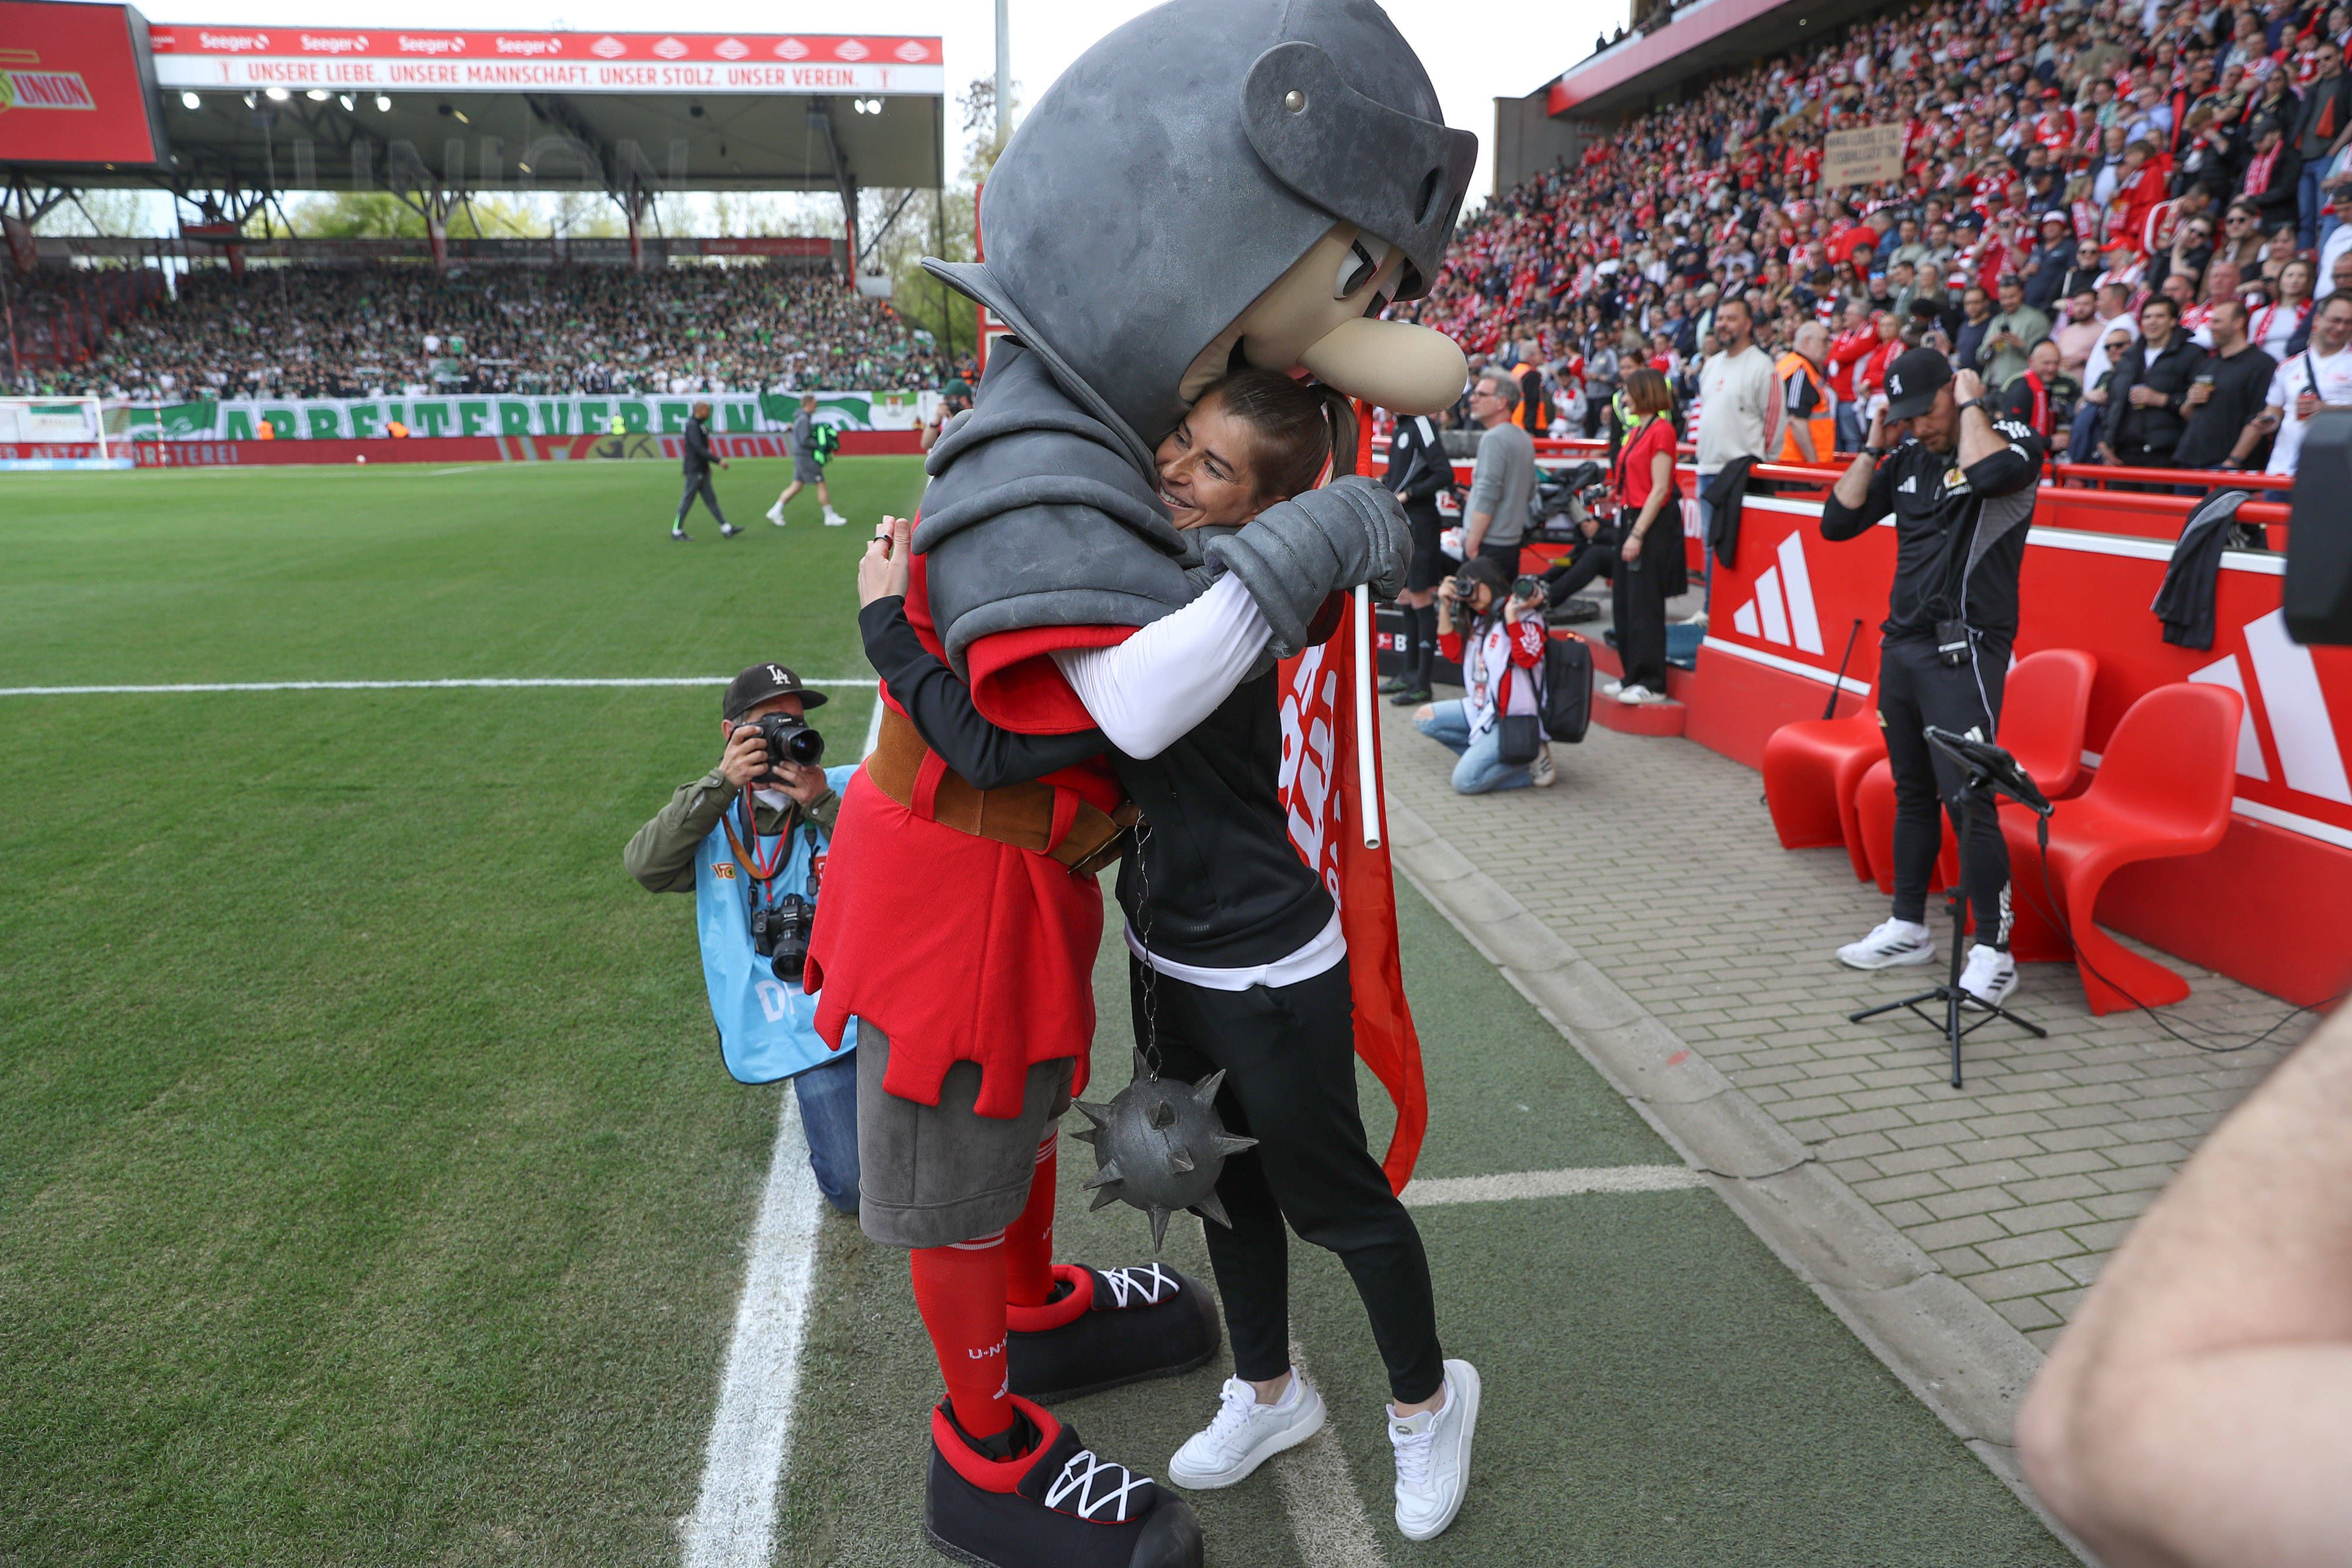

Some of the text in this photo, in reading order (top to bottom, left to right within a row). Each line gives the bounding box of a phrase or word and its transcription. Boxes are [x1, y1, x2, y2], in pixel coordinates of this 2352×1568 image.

[199, 31, 255, 52] Seeger
[300, 33, 353, 54] Seeger
[397, 34, 451, 55] Seeger
[495, 36, 547, 56] Seeger
[248, 62, 860, 86] UNSERE LIEBE. UNSERE MANNSCHAFT. UNSER STOLZ. UNSER VEREIN.
[11, 74, 89, 105] UNION
[766, 664, 791, 686] LA
